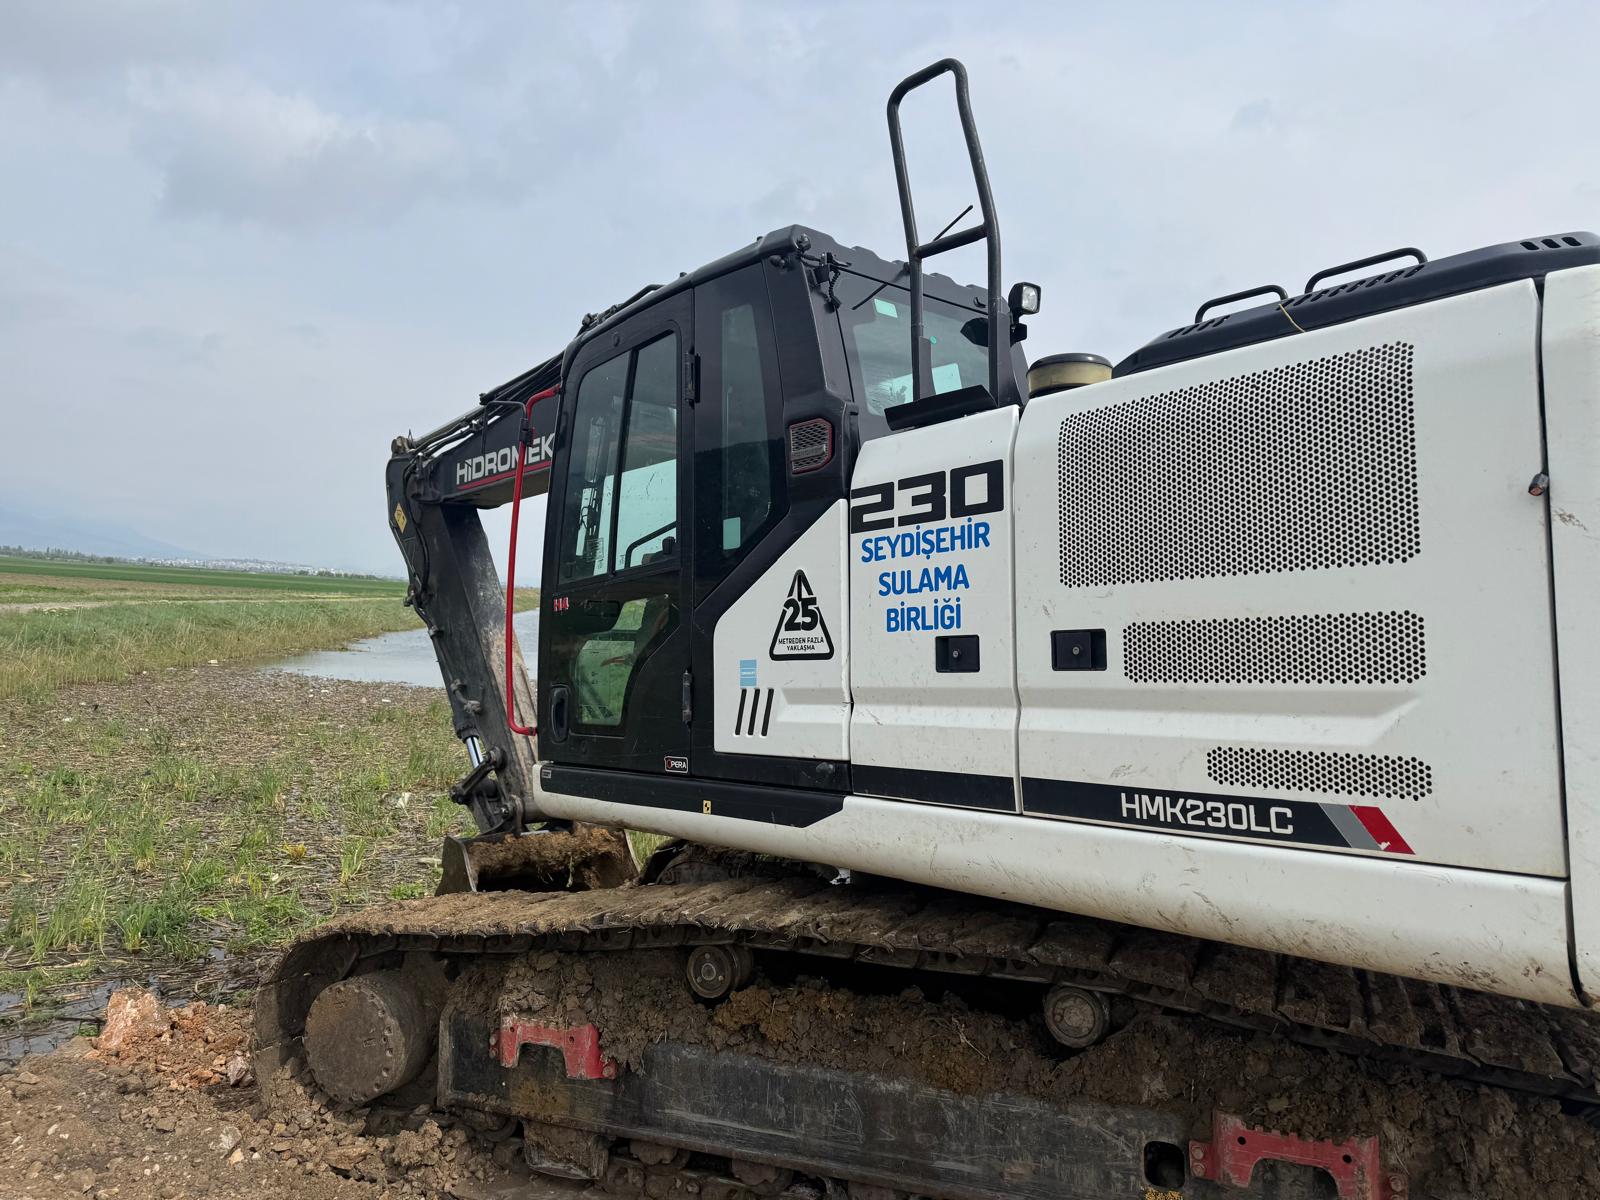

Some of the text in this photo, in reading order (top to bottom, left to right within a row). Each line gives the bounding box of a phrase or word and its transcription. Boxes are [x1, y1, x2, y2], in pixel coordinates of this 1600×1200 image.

[850, 459, 1004, 534] 230
[861, 517, 991, 563] SEYDİŞEHİR
[878, 564, 970, 596] SULAMA
[783, 597, 819, 631] 25
[886, 597, 962, 632] BİRLİĞİ
[778, 636, 824, 645] METREDEN FAZLA
[1121, 792, 1294, 835] HMK230LC
